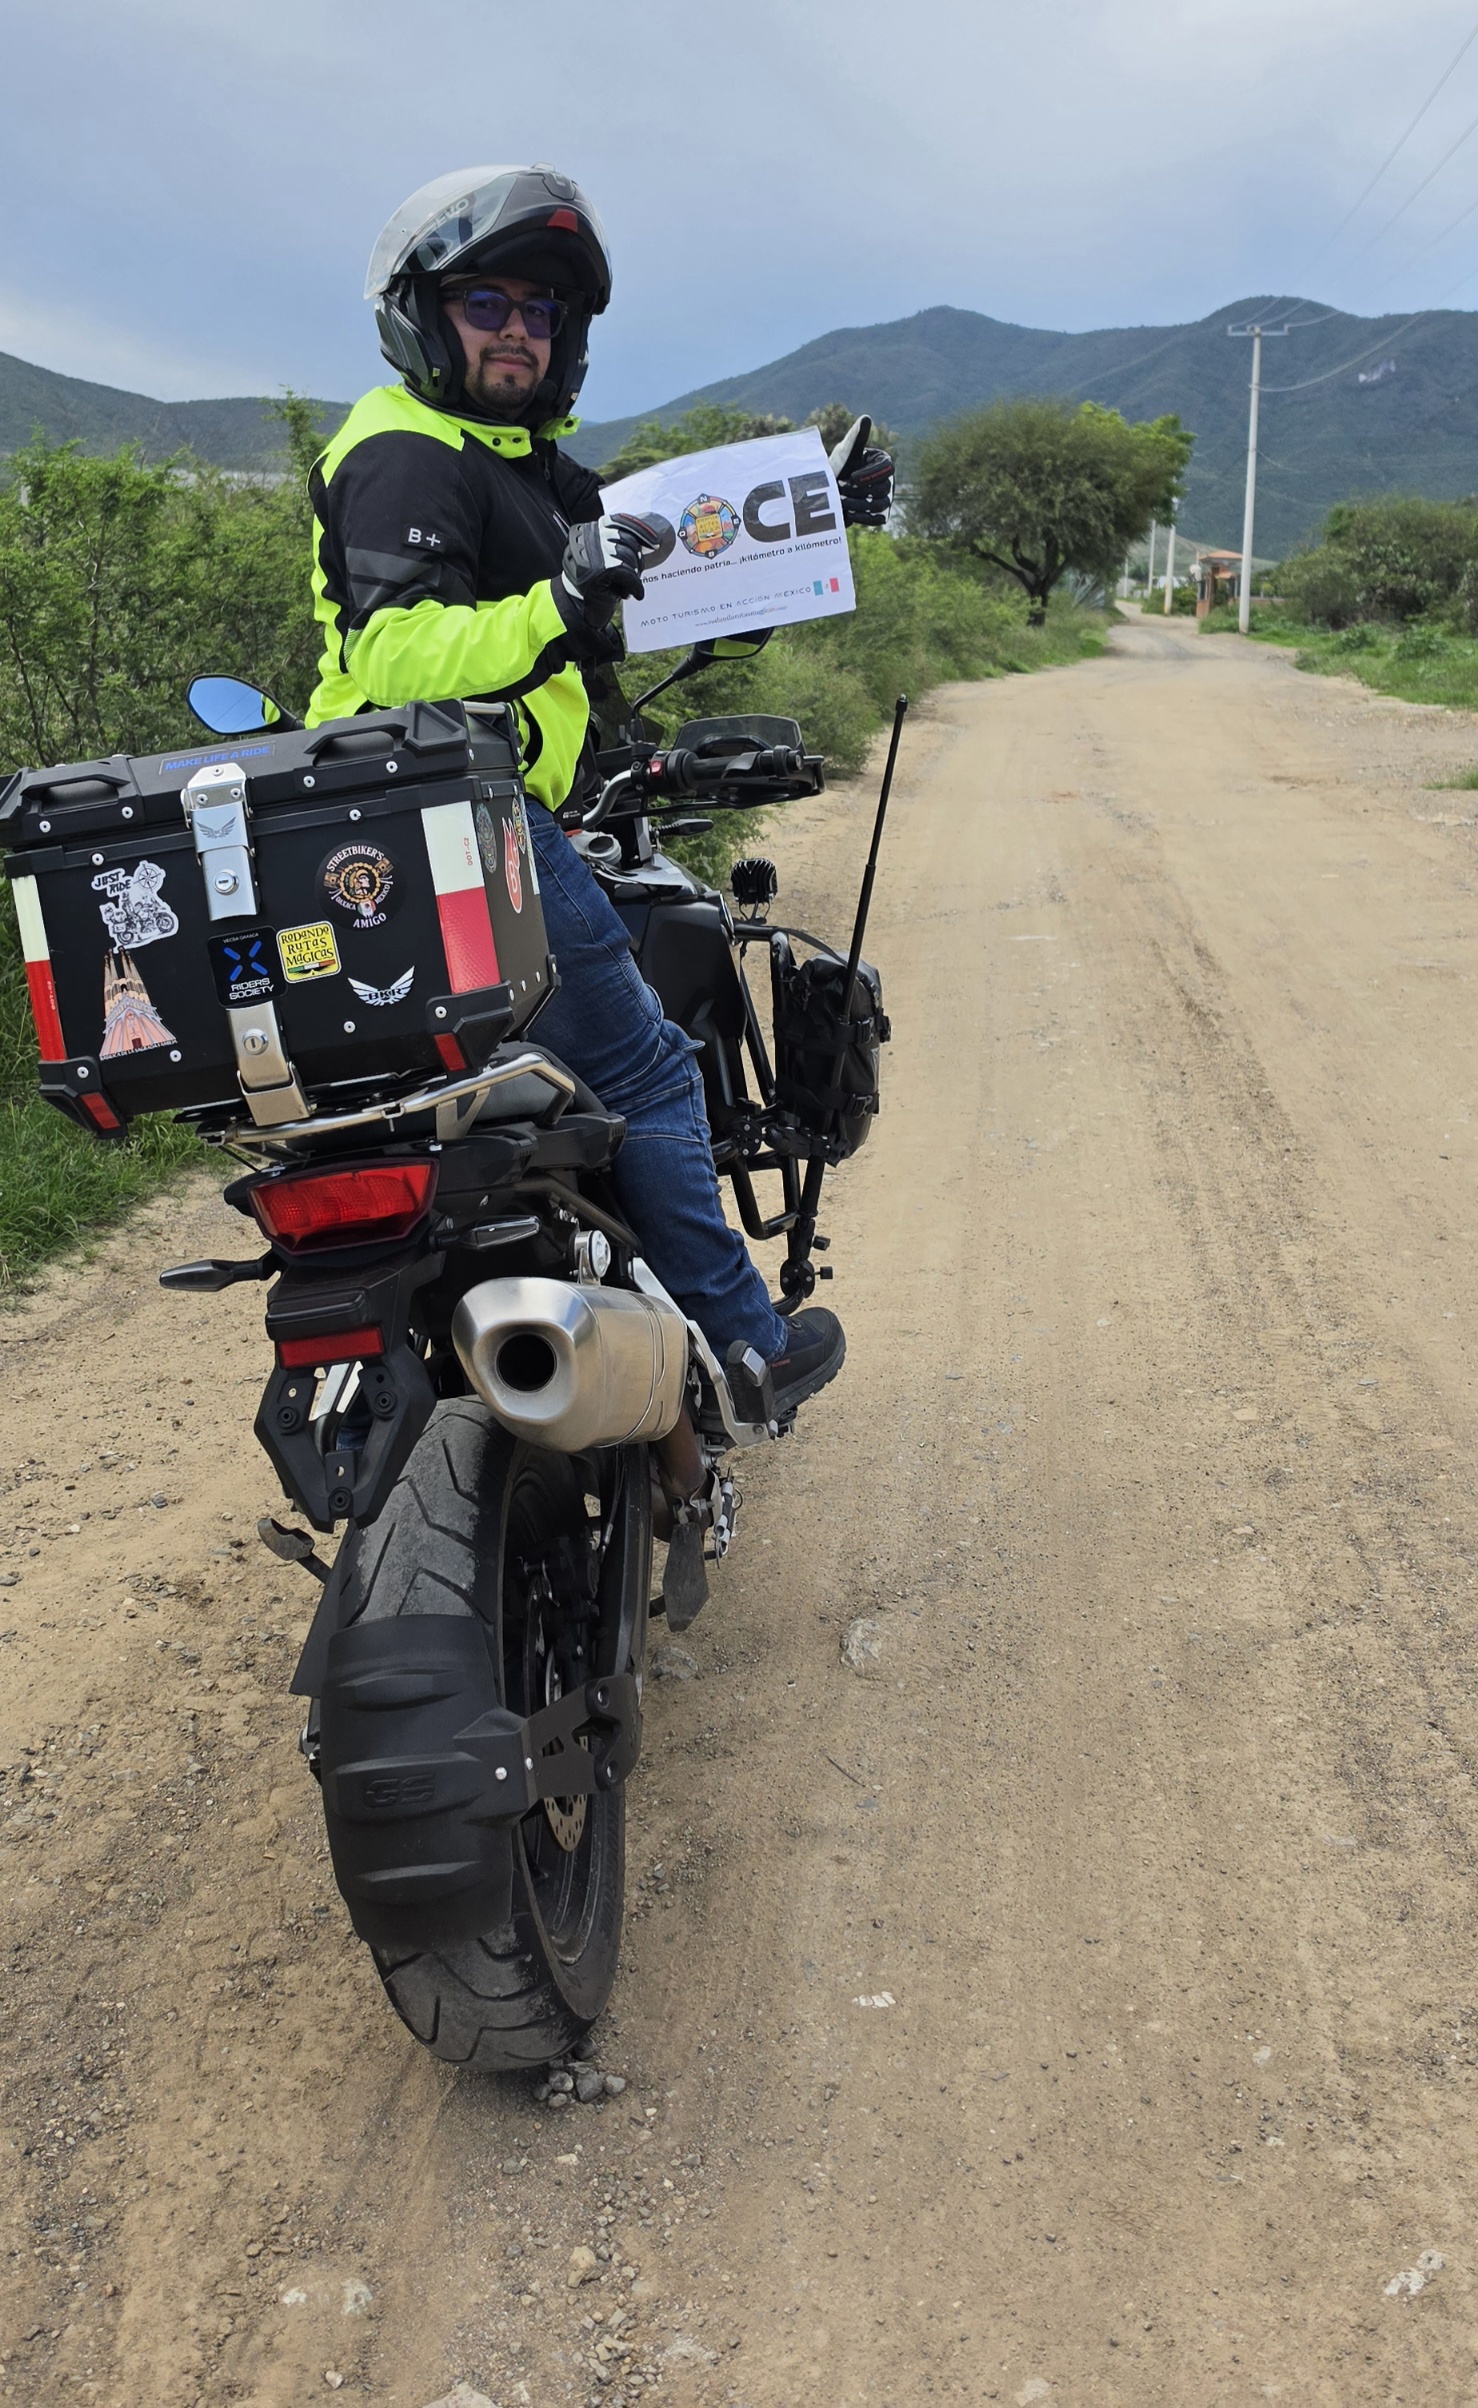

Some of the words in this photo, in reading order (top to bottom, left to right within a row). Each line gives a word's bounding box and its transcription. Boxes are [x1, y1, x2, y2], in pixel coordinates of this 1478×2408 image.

[661, 565, 702, 580] haciendo
[787, 546, 793, 554] a
[640, 615, 669, 627] MOTO
[671, 605, 716, 620] TURISMO
[720, 602, 733, 610] EN
[774, 586, 812, 598] MEXICO
[165, 757, 201, 771] MAKE
[203, 752, 228, 764] LIFE
[241, 745, 270, 757] RIDE
[326, 845, 385, 873] STREETBIKER'S
[94, 870, 121, 887] JUST
[109, 879, 132, 894] RIDE
[352, 912, 387, 929] AMIGO
[229, 984, 275, 1000] SOCIETY
[231, 977, 271, 992] RIDERS
[368, 988, 402, 1001] BKR
[364, 1774, 436, 1808] GS
